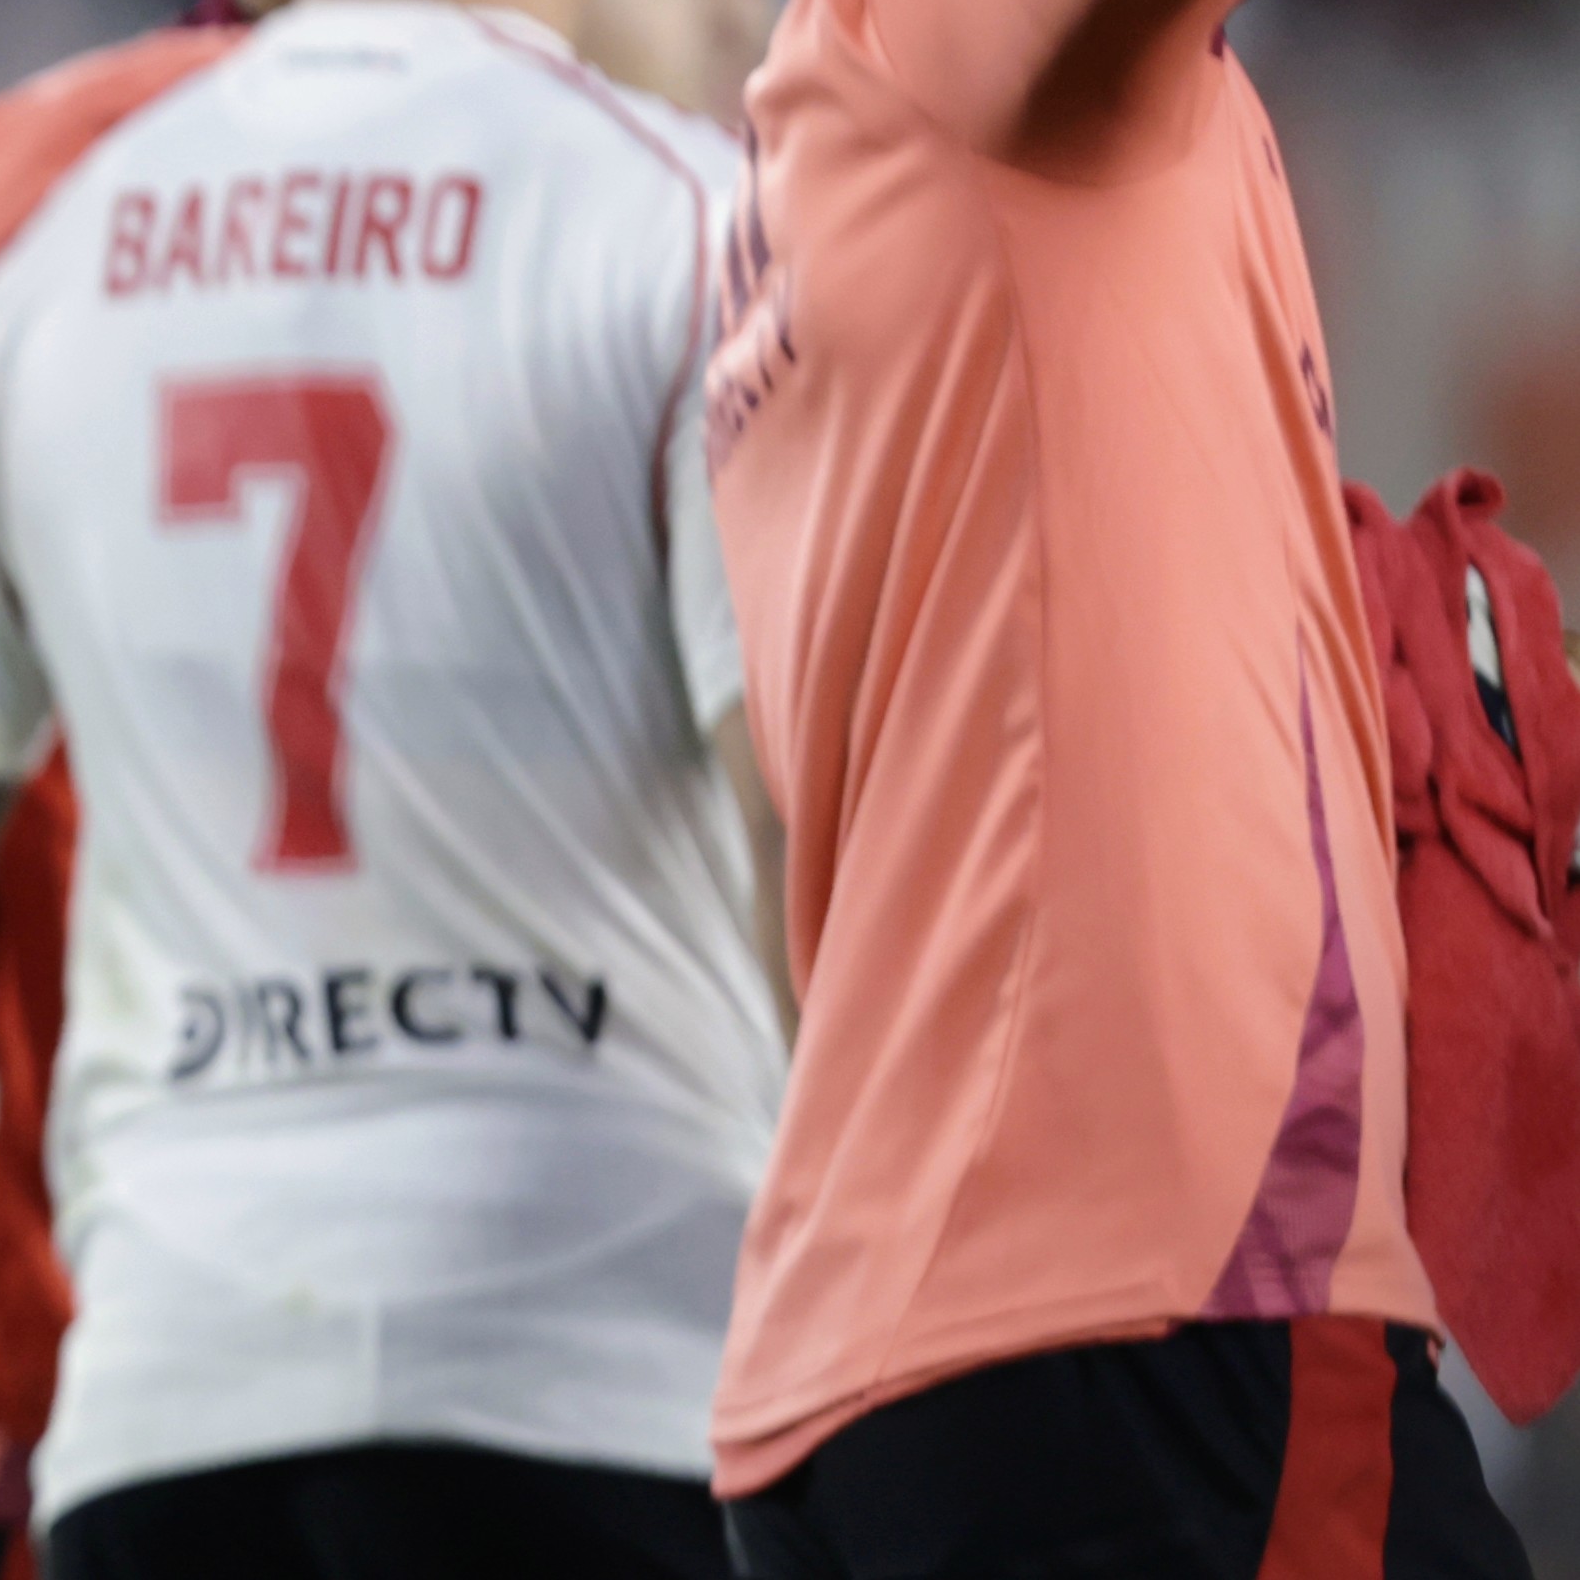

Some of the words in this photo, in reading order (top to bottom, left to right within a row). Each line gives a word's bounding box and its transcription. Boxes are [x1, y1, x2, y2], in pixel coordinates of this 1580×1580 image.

[105, 170, 484, 298] BAREIRO
[158, 372, 396, 876] 7
[171, 966, 607, 1082] DIRECTV
